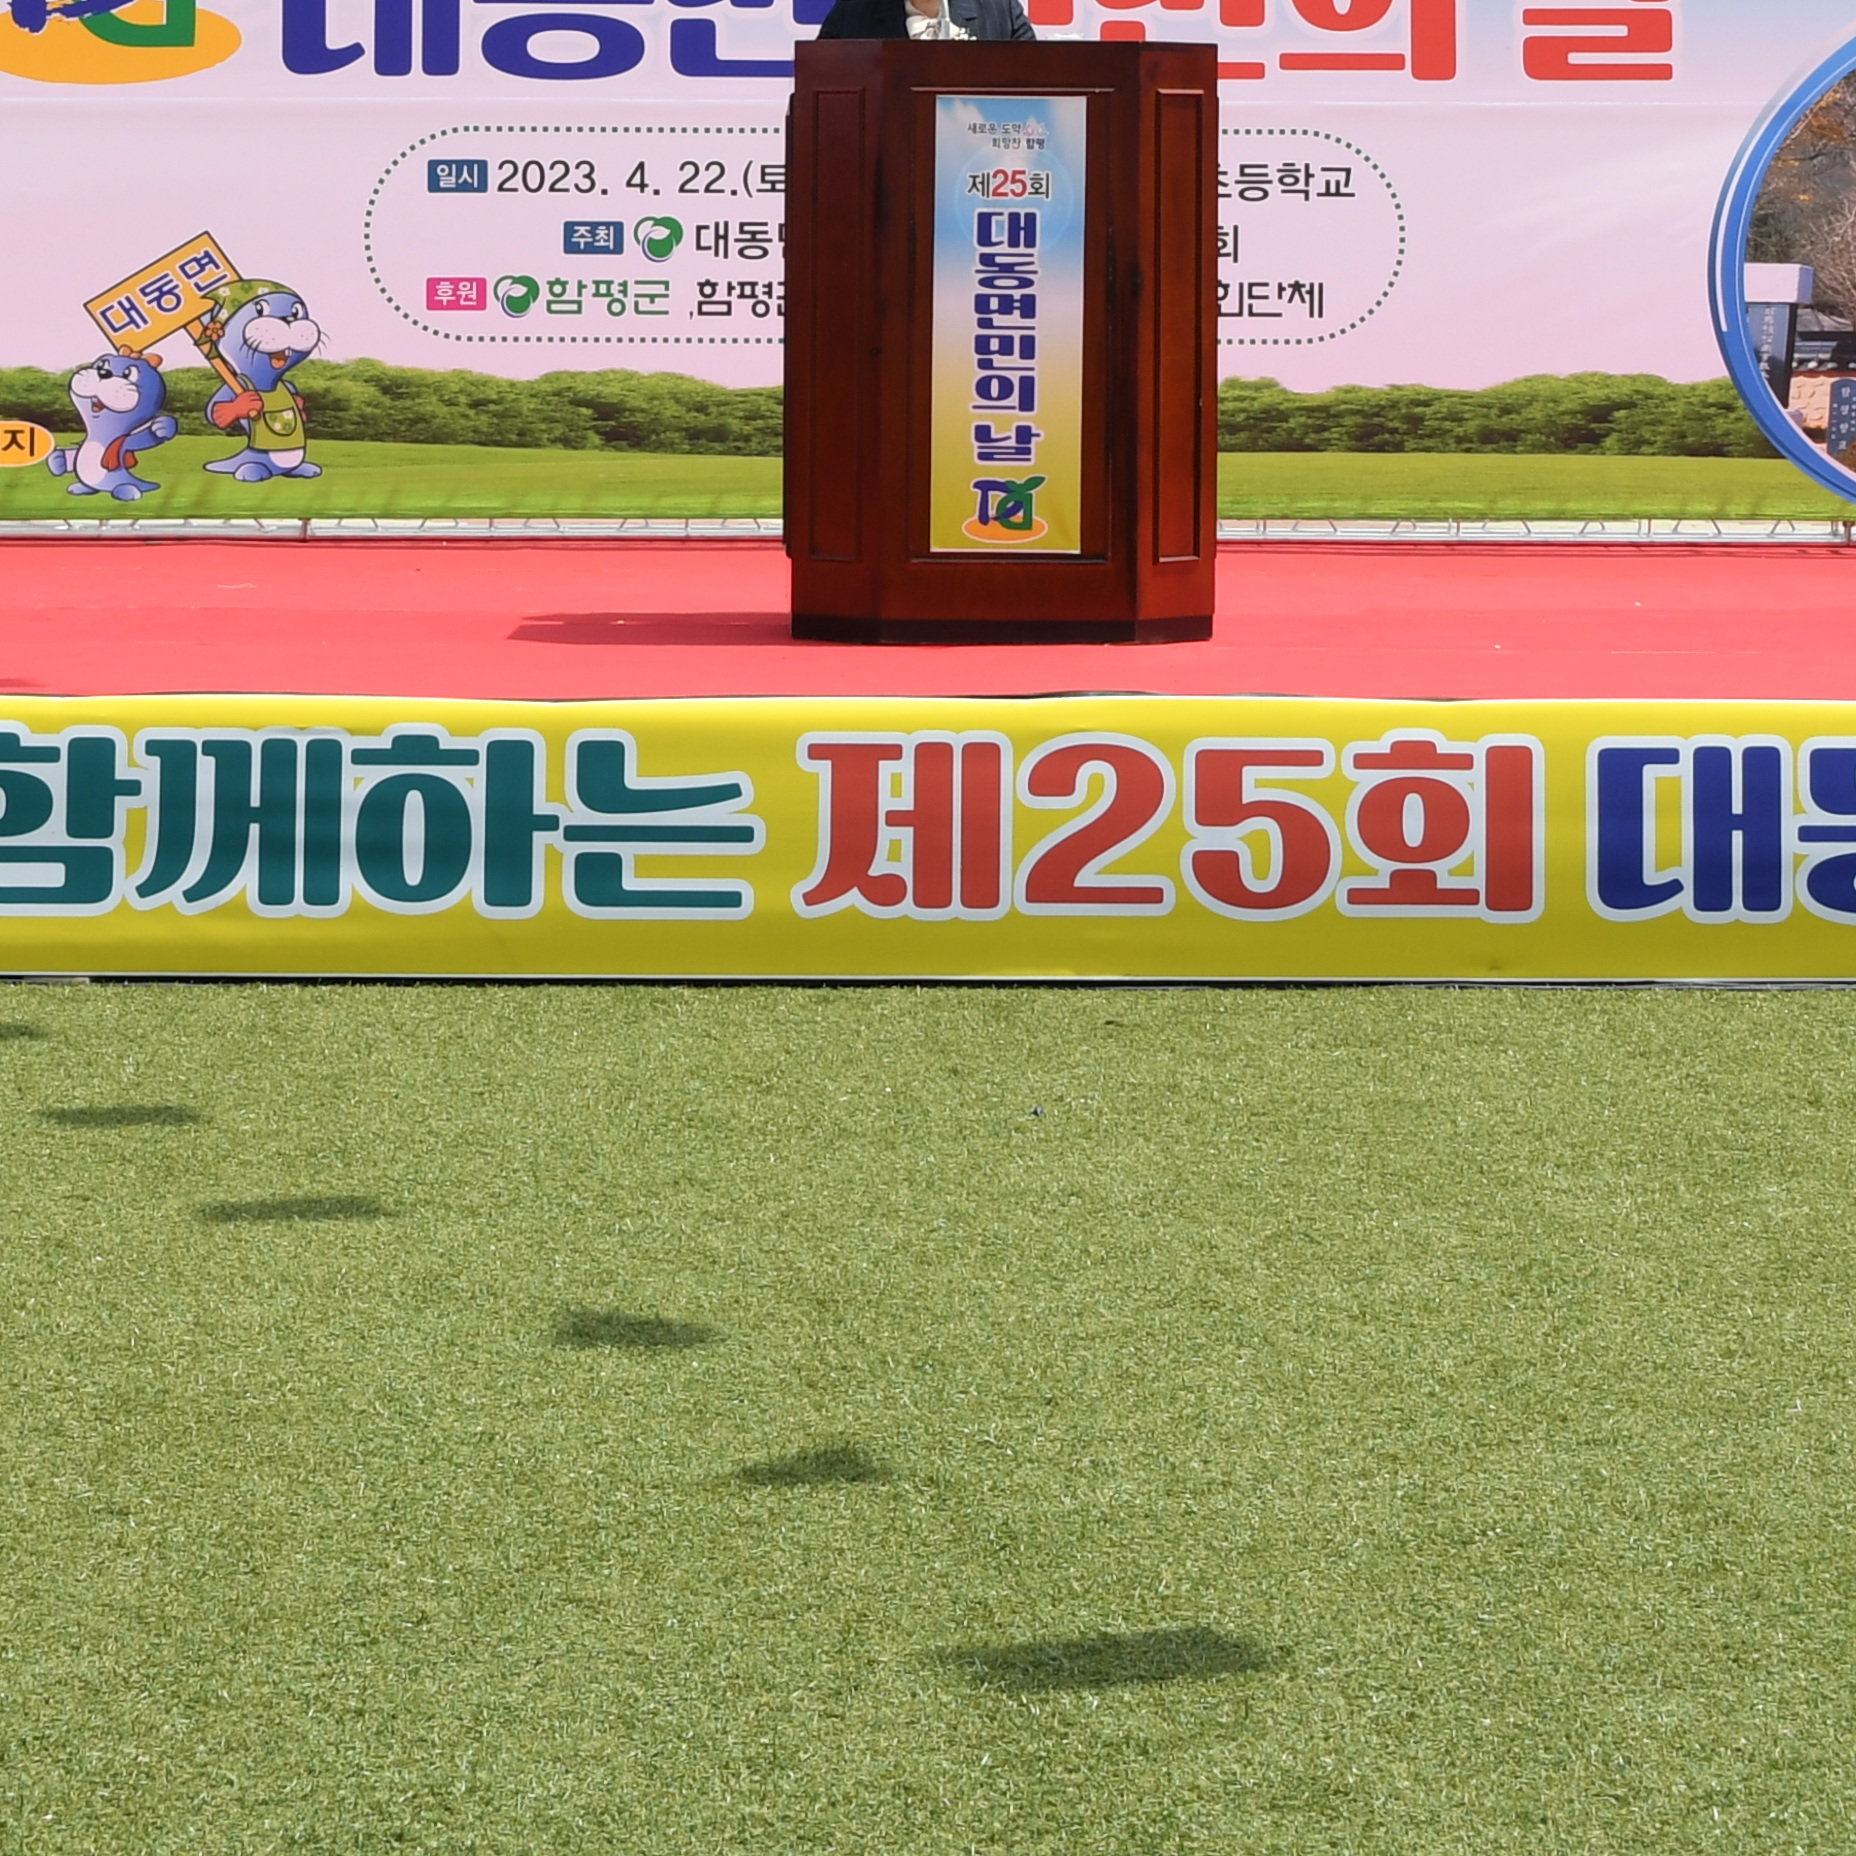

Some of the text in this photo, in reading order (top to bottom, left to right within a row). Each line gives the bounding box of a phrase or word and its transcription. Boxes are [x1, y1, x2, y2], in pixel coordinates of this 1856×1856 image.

[436, 163, 478, 188] 일시
[497, 160, 609, 195] 2023.
[625, 160, 661, 195] 4.
[967, 168, 1049, 199] 제25회
[571, 226, 614, 250] 주최
[695, 220, 786, 260] 대동
[99, 249, 228, 334] 대동면
[434, 282, 478, 306] 후원
[546, 278, 670, 317] 함평군
[972, 211, 1041, 462] 대동면민의 날
[801, 739, 1534, 913] 제25회
